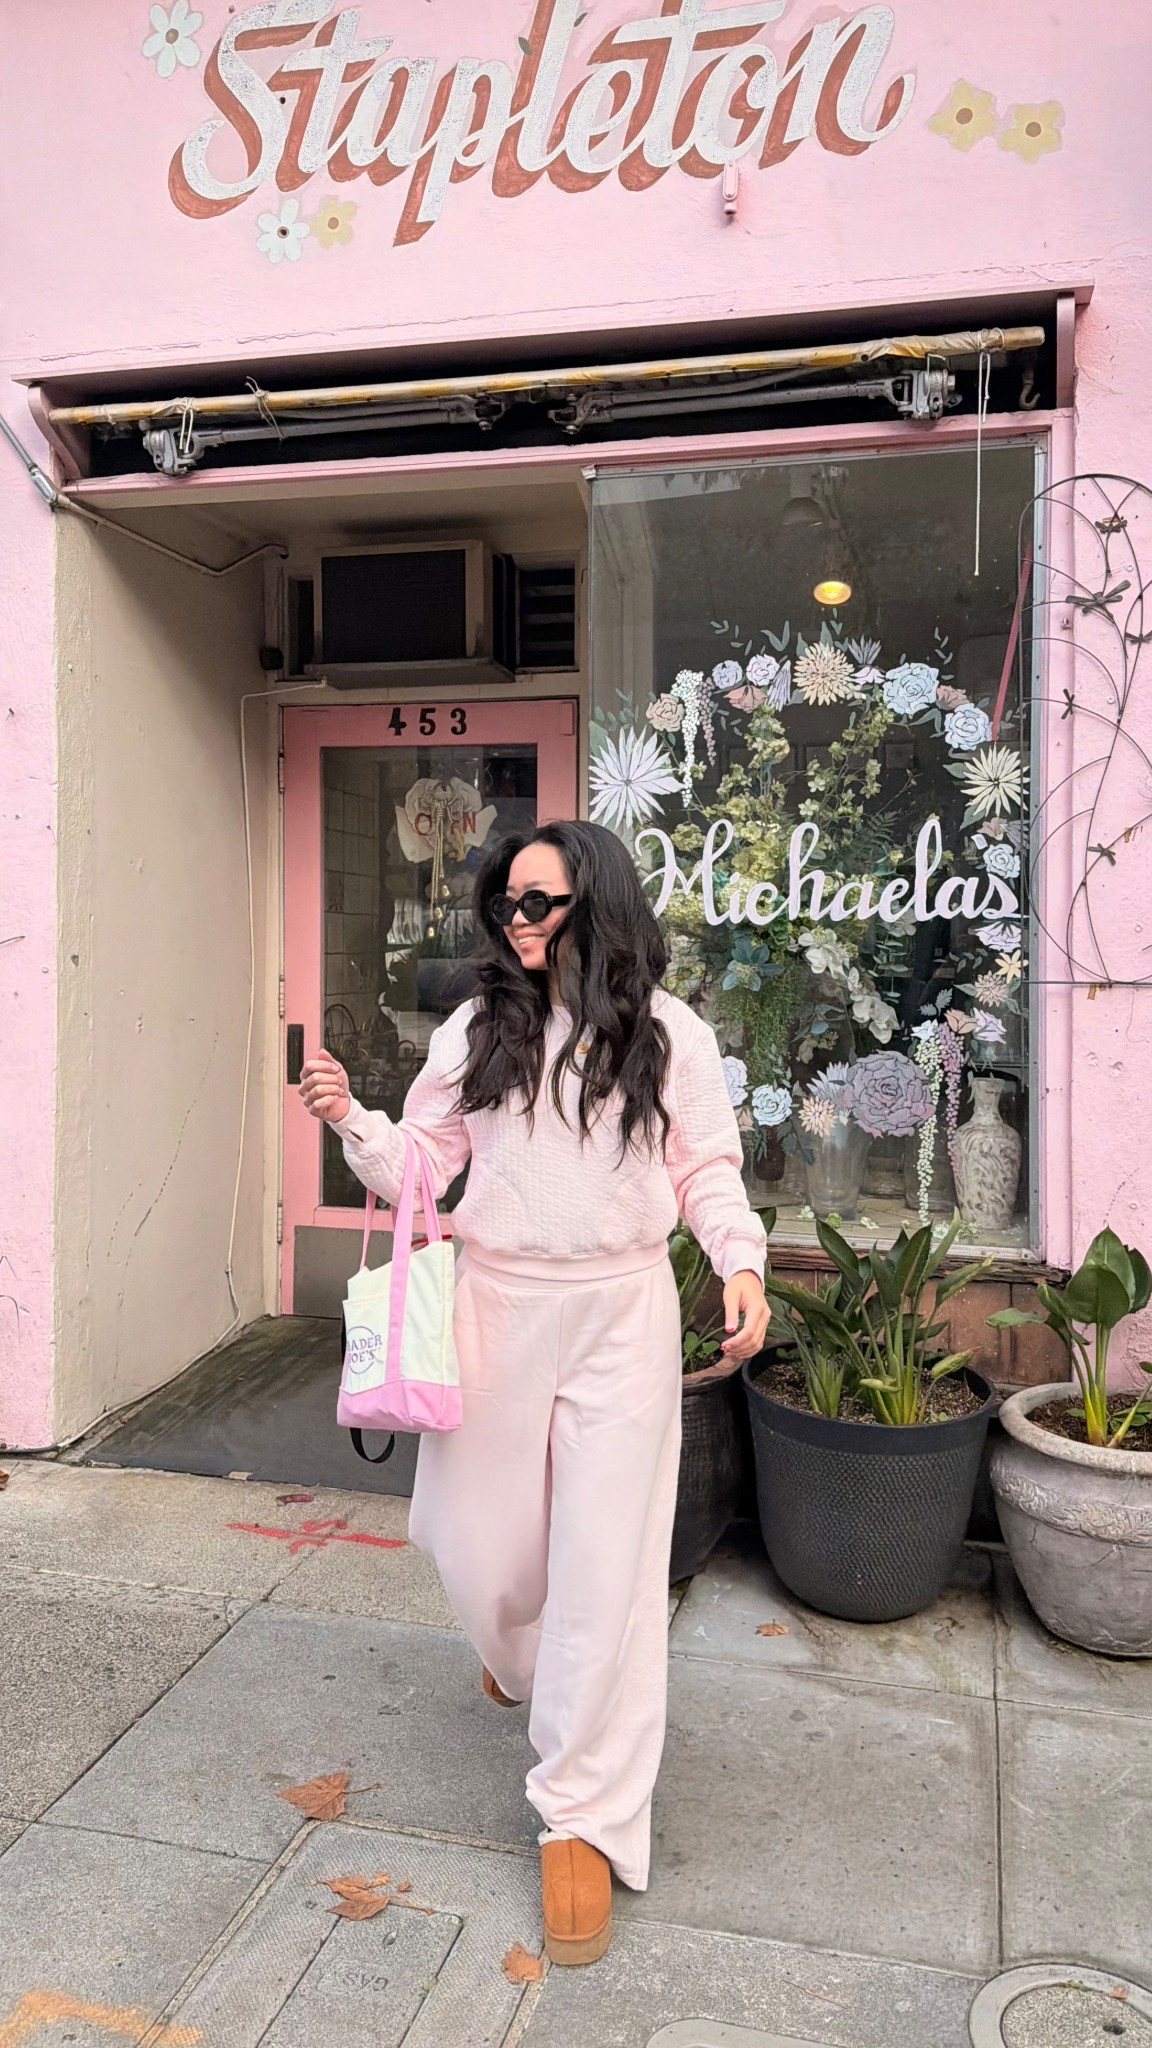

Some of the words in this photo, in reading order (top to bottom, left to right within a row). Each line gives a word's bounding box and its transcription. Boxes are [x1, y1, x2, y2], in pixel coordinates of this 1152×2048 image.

[168, 0, 917, 246] Stapleton
[387, 707, 467, 736] 453
[414, 811, 477, 836] OEN
[347, 1334, 383, 1351] ADER
